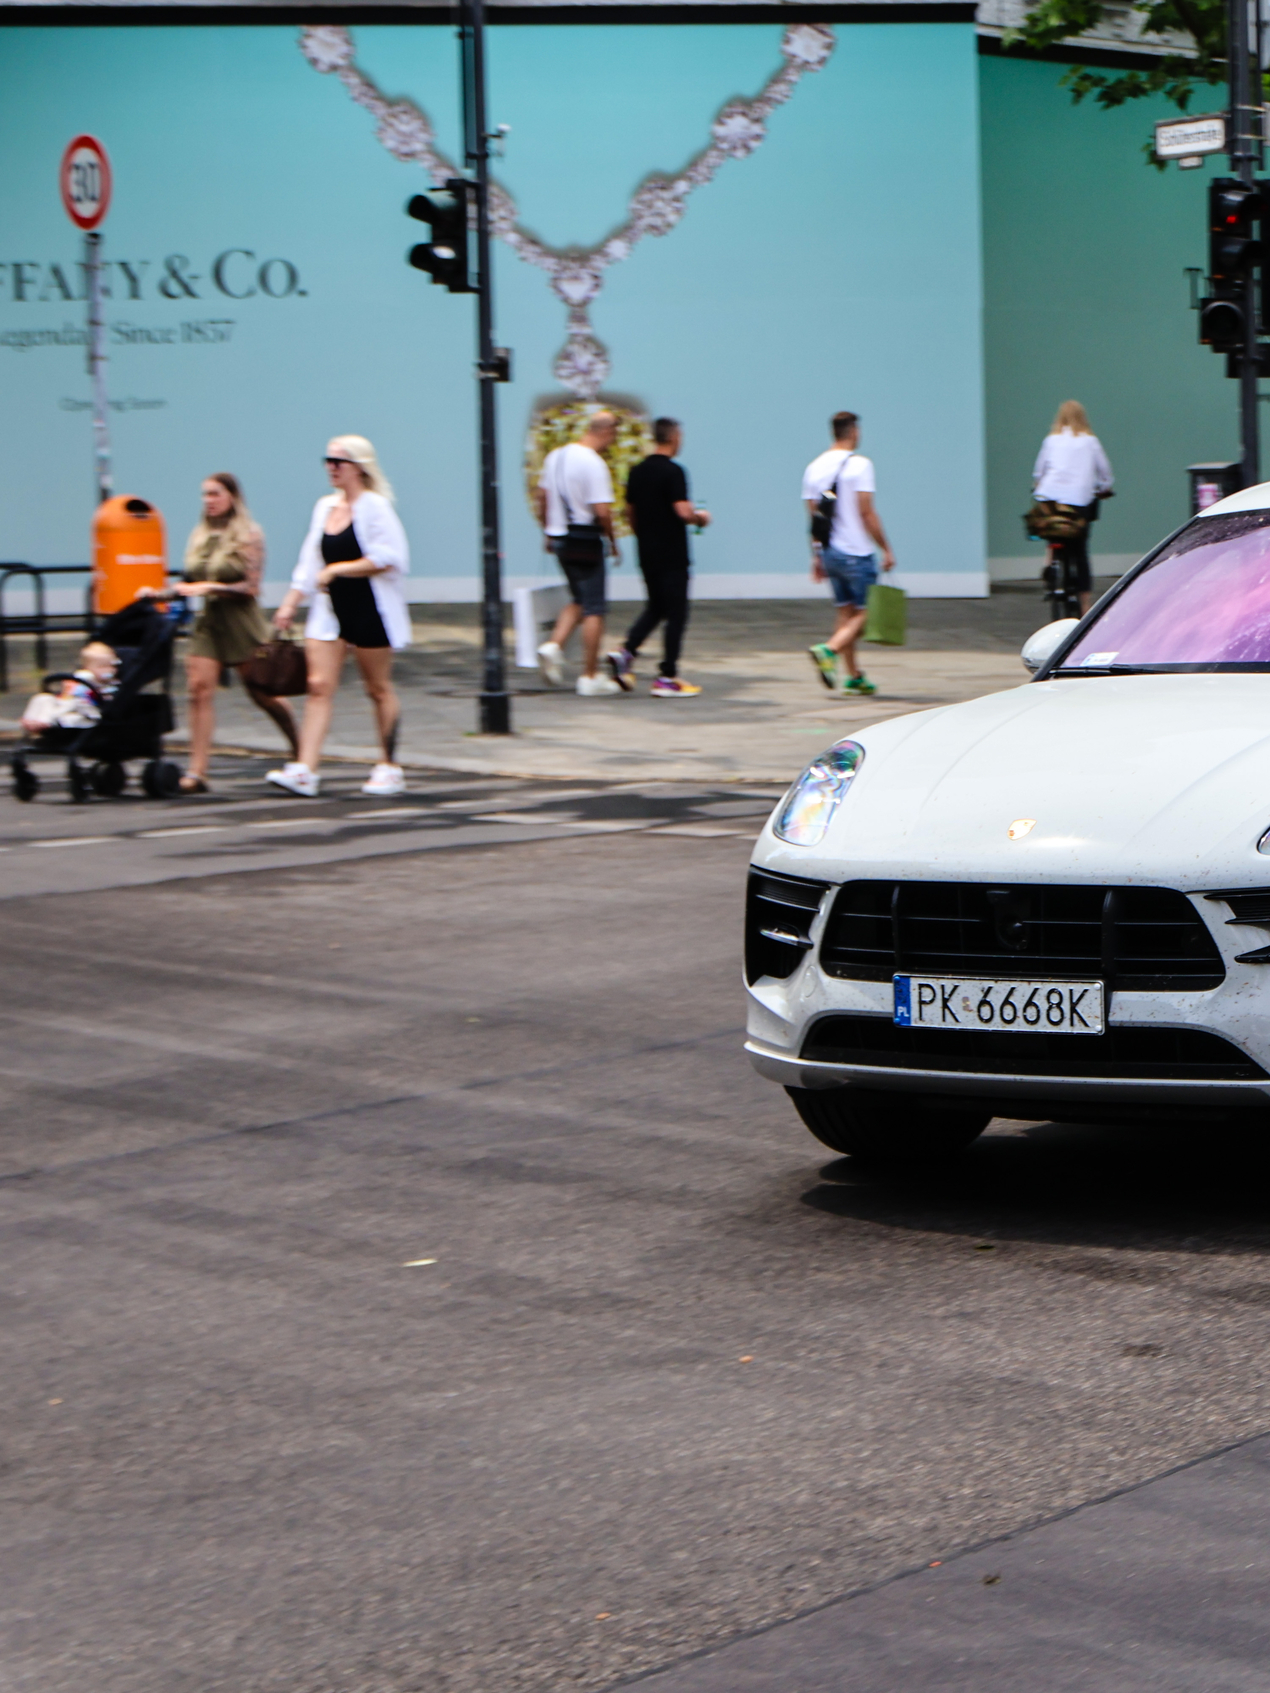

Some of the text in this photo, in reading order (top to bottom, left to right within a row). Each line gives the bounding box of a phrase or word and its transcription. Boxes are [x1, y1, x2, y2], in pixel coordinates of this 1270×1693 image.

[897, 1006, 910, 1017] PL
[917, 982, 1091, 1028] PK 6668K
